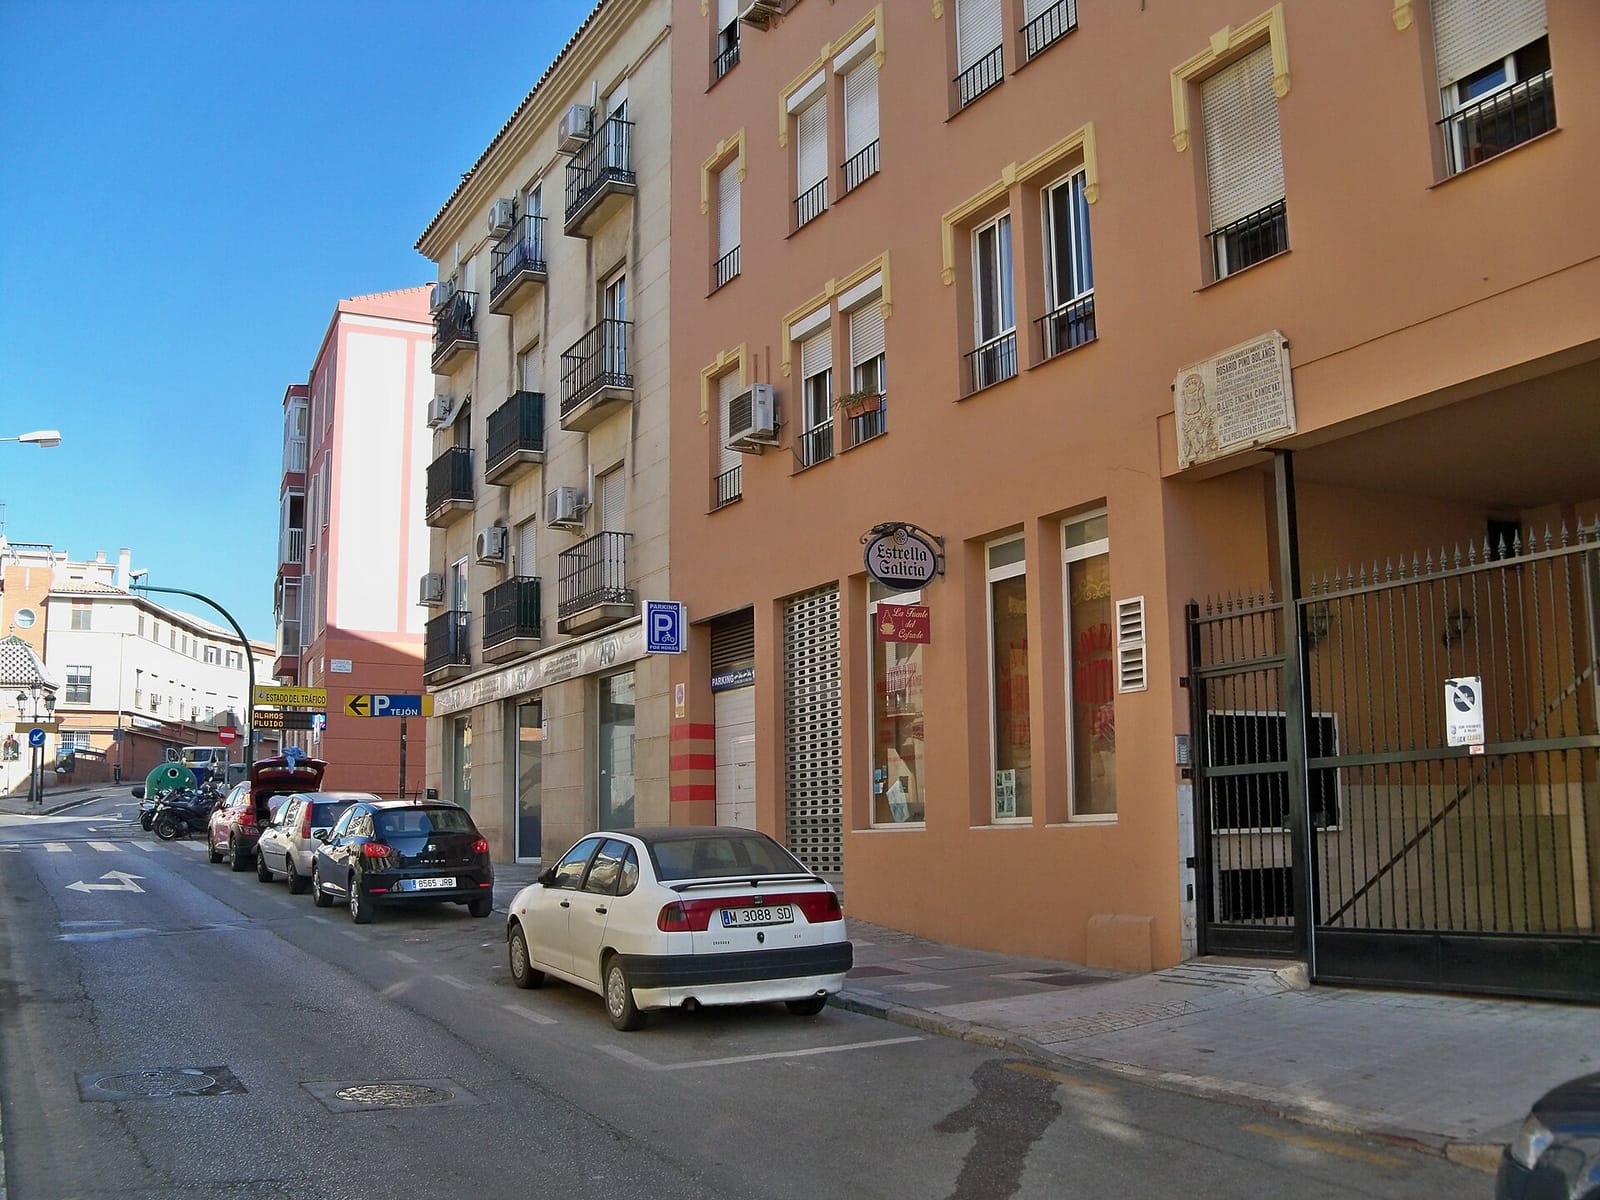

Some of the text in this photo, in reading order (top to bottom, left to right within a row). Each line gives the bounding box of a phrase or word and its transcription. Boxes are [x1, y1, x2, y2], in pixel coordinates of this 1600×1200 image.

[877, 544, 927, 562] Estrella
[880, 560, 925, 577] Galicia
[892, 607, 904, 617] La
[904, 620, 916, 628] del
[711, 674, 734, 687] PARKING
[266, 693, 326, 704] ESTADO DEL TRÁFICO
[374, 695, 418, 716] P TEJÓN
[254, 712, 284, 720] ALAMOS
[254, 720, 284, 728] FLUIDO
[729, 907, 792, 924] M 3088 SD
